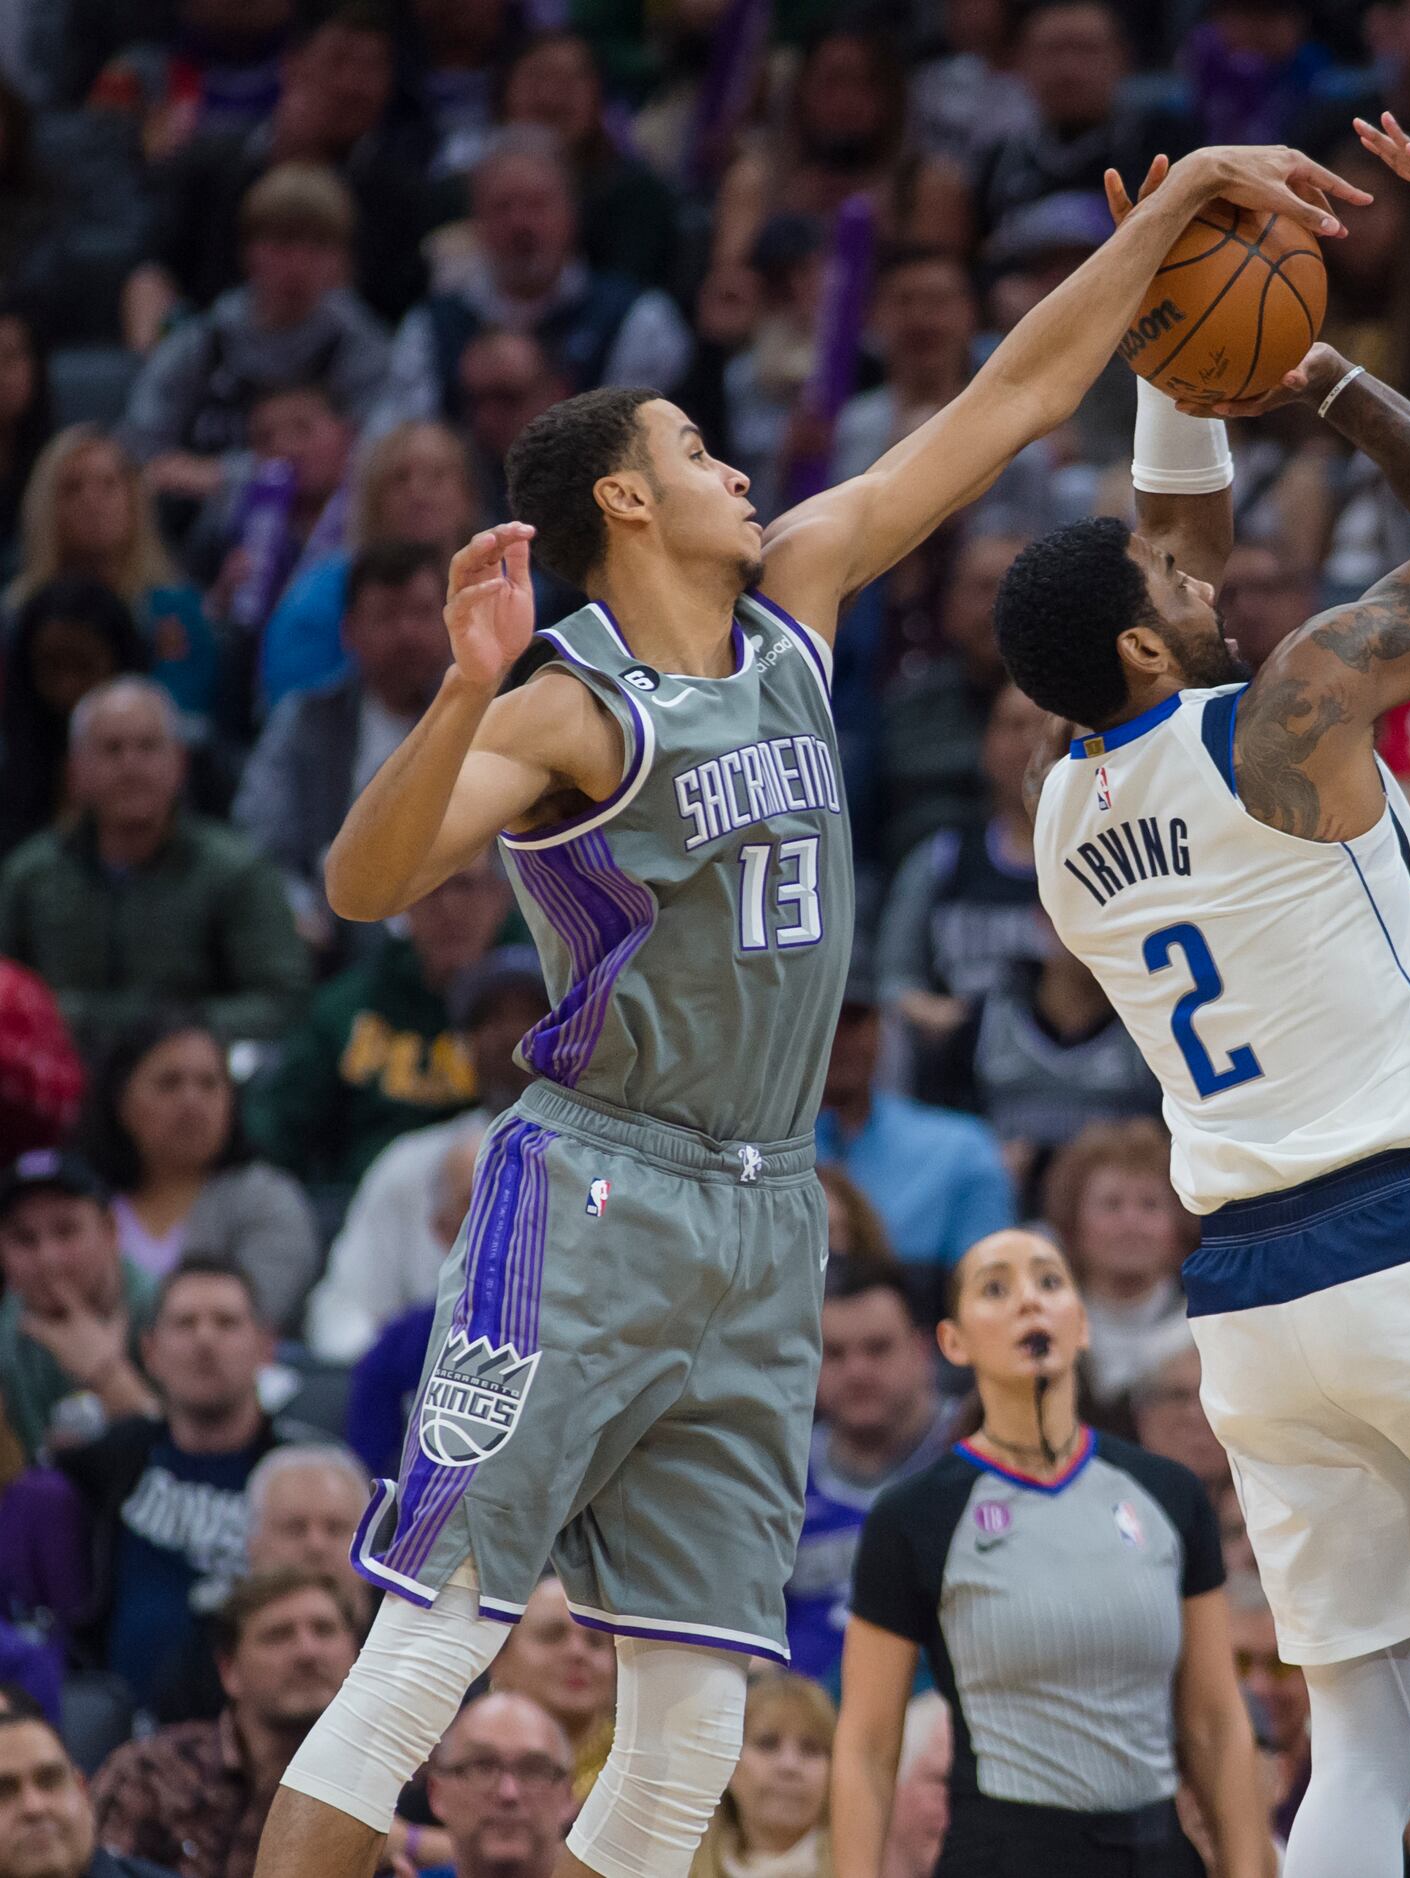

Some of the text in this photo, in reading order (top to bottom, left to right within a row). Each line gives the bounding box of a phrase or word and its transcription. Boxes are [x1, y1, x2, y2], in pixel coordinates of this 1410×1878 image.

[755, 634, 794, 674] alpad
[624, 670, 655, 691] 6
[1063, 816, 1191, 907] IRVING
[739, 834, 823, 951] 13
[1142, 921, 1265, 1101] 2
[424, 1381, 519, 1428] KINGS
[434, 1368, 520, 1397] SACRAMENTO
